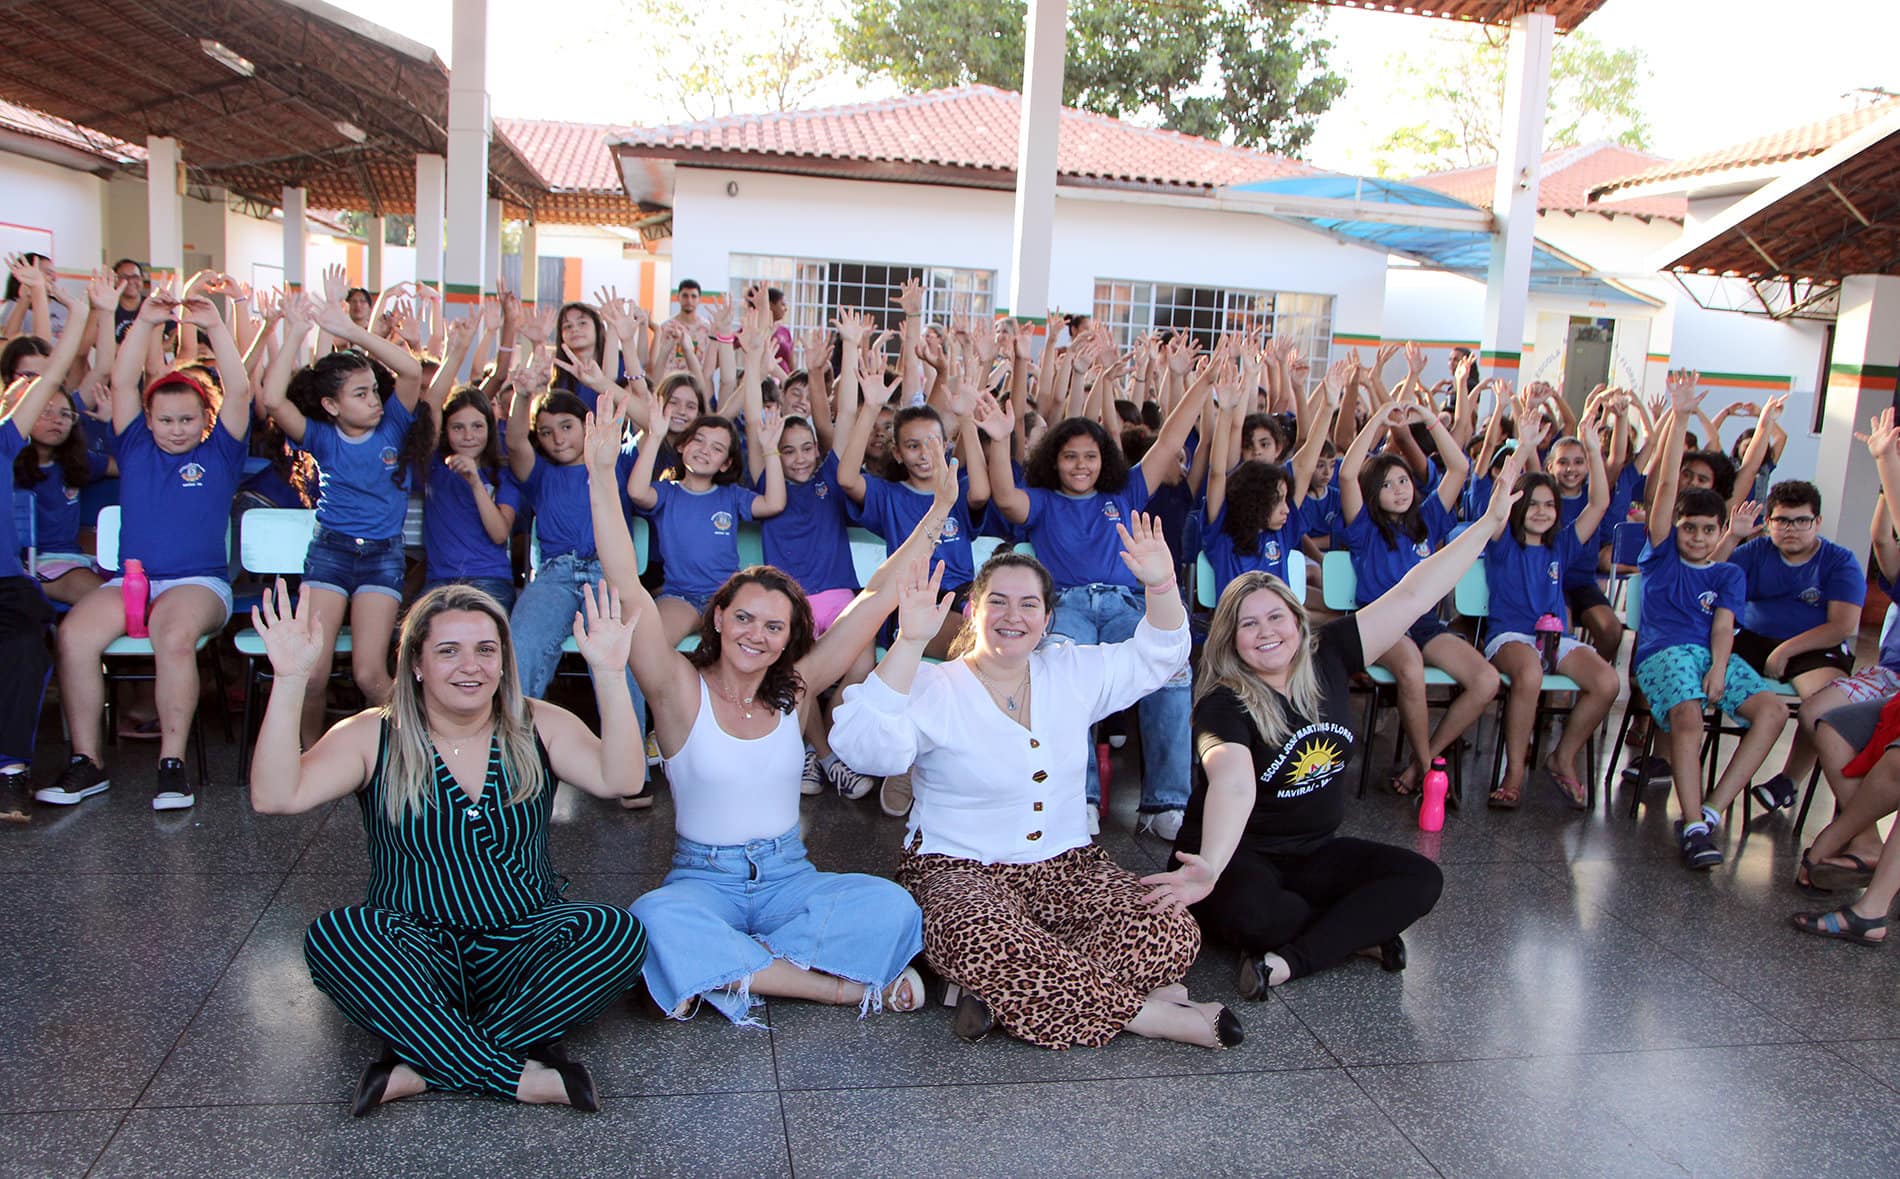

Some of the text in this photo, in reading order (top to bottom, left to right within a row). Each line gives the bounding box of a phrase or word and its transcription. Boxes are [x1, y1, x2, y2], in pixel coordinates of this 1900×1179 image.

[1260, 753, 1287, 782] ESCOLA
[1296, 722, 1330, 739] MARTINS
[1330, 723, 1354, 743] FLORES
